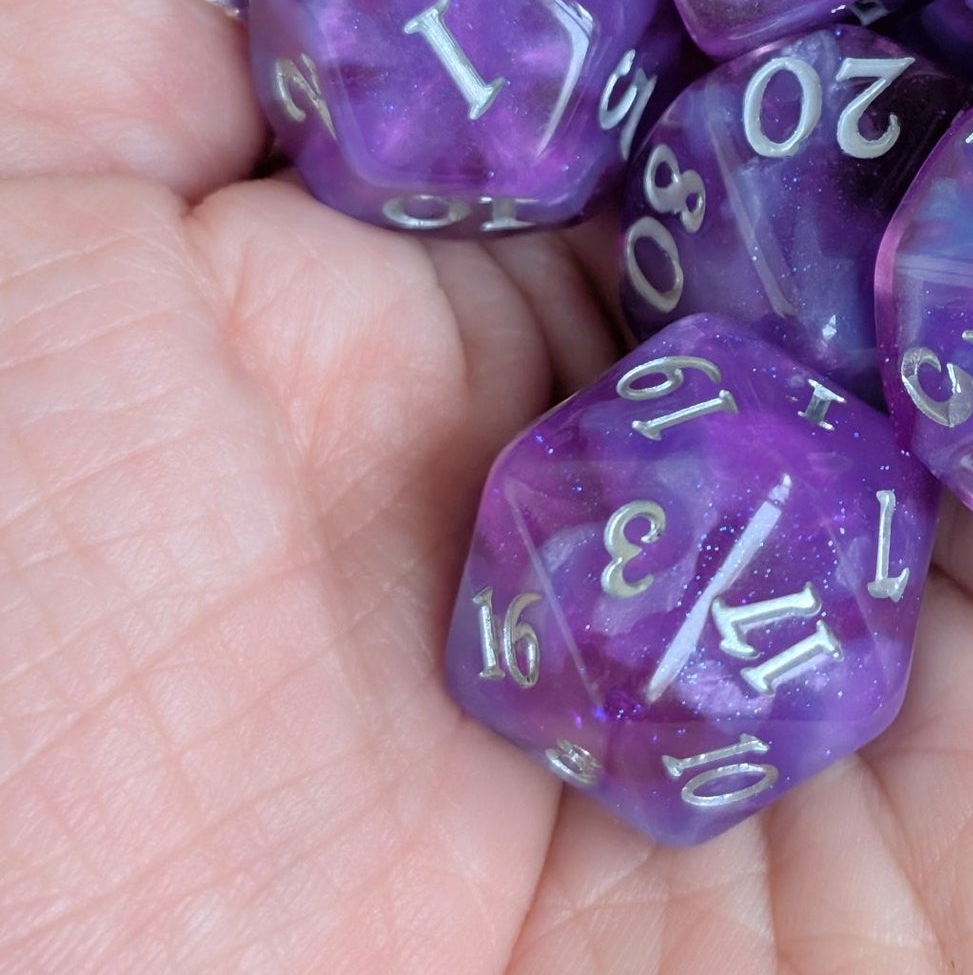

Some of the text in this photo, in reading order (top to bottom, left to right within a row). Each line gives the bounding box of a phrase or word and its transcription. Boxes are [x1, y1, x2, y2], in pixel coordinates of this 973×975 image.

[275, 53, 339, 142] 2
[599, 49, 659, 162] 5
[742, 56, 916, 160] 20
[382, 194, 540, 232] 10
[624, 143, 707, 315] 80
[616, 355, 739, 442] 19
[797, 378, 848, 431] 1
[601, 499, 667, 600] 3
[471, 585, 543, 690] 16
[712, 581, 844, 698] 17
[661, 733, 780, 808] 10
